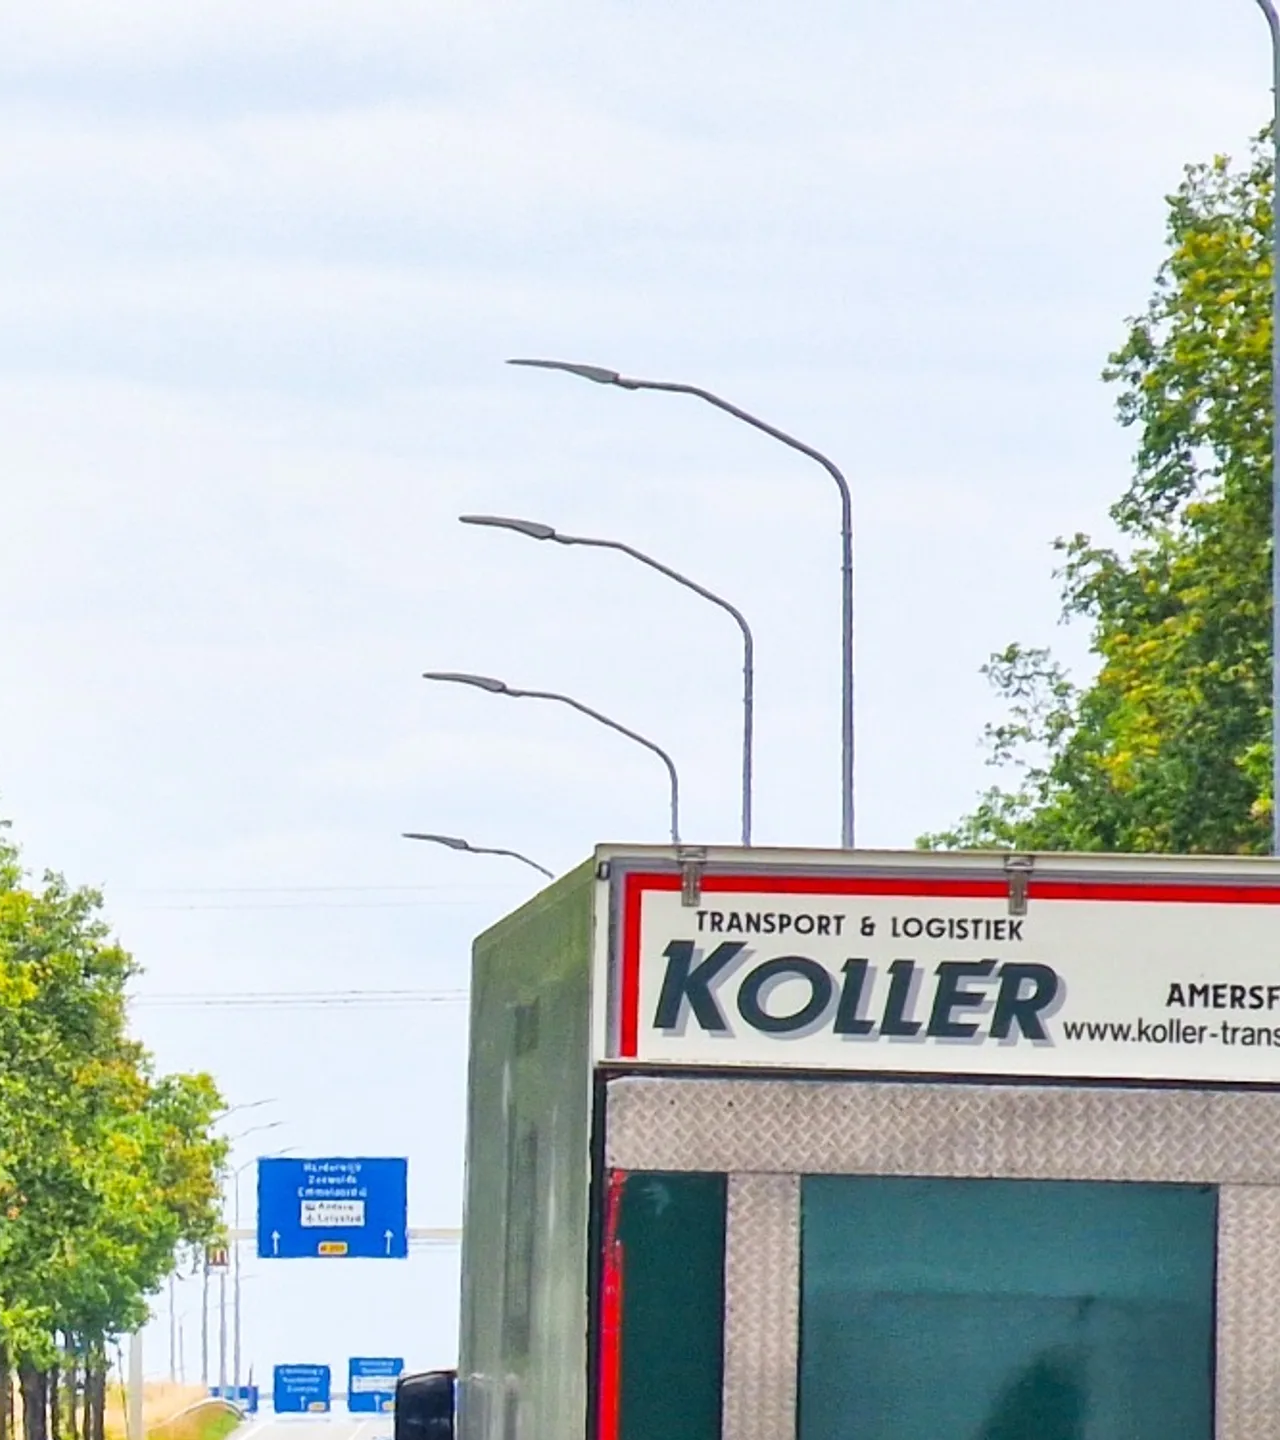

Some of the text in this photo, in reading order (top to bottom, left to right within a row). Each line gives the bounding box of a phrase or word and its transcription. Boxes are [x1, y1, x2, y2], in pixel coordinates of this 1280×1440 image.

[696, 910, 1024, 941] TRANSPORT & LOGISTIEK
[652, 938, 1069, 1048] KOLLER
